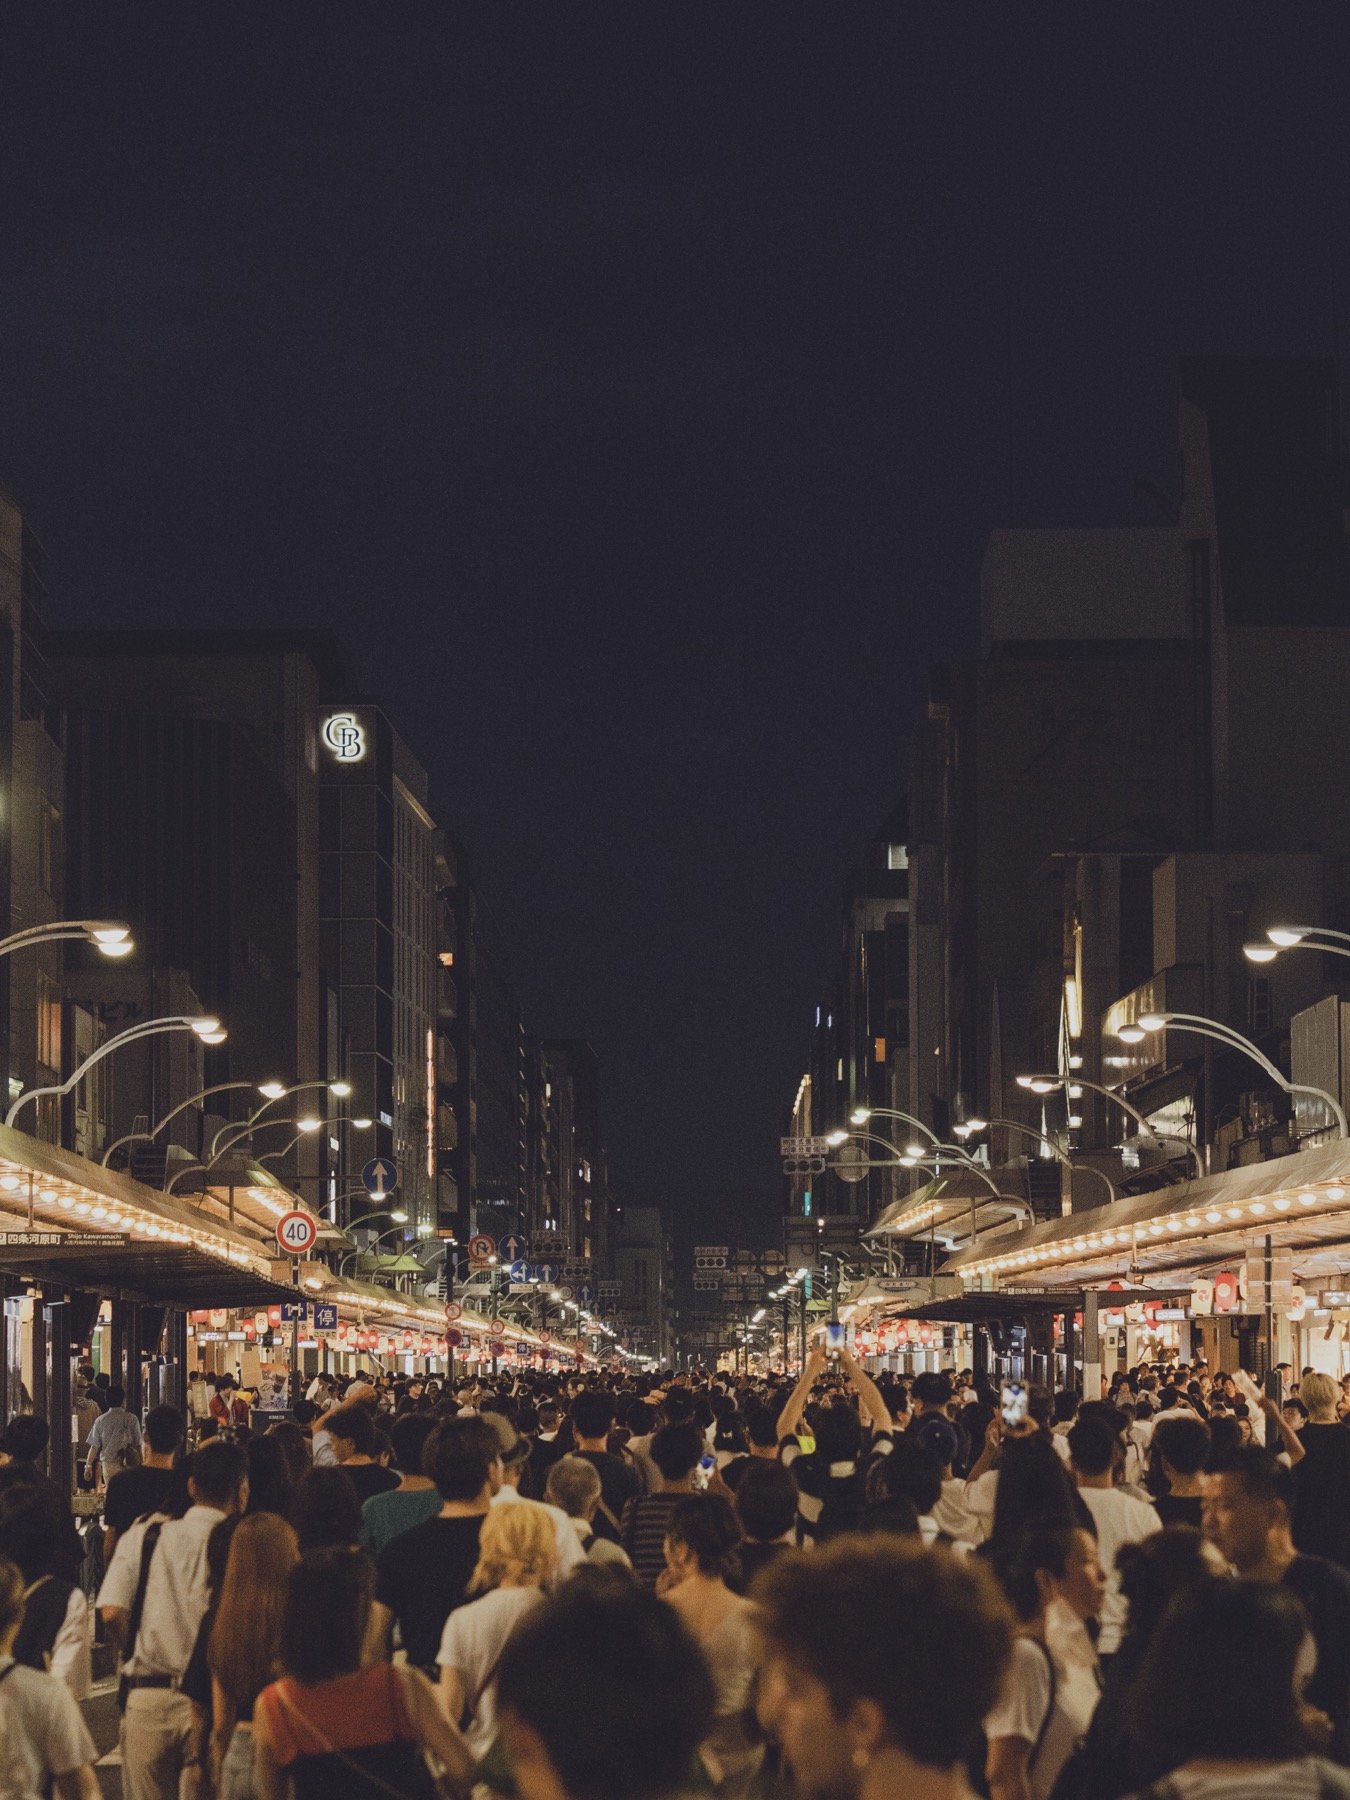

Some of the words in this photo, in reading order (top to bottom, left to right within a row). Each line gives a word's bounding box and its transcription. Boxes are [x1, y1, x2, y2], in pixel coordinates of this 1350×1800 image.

[67, 1233, 83, 1241] Shijo
[286, 1223, 307, 1242] 40
[7, 1233, 62, 1245] 四条河原町
[317, 1308, 335, 1326] 停
[281, 1323, 307, 1331] ここら
